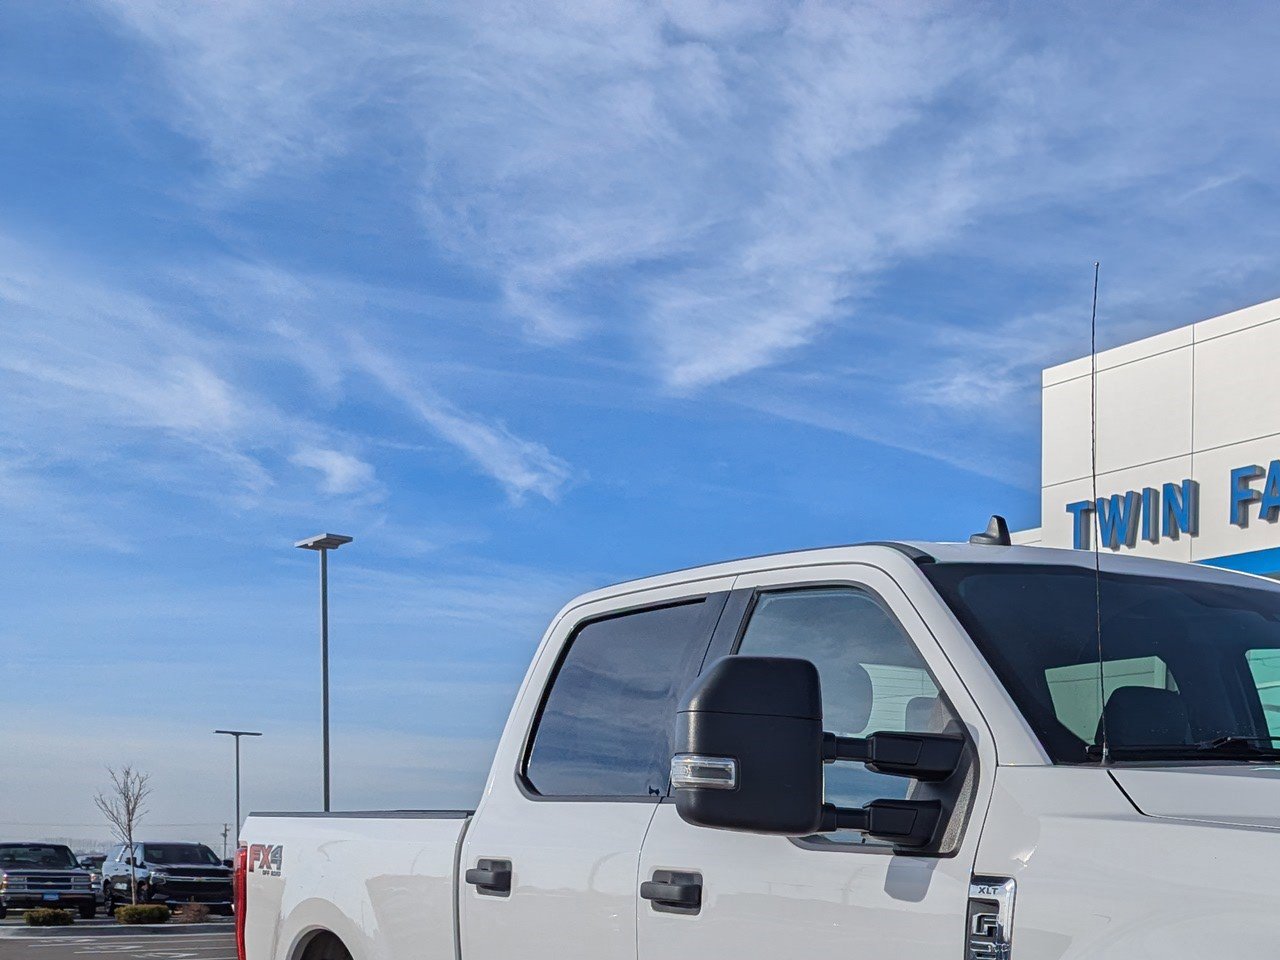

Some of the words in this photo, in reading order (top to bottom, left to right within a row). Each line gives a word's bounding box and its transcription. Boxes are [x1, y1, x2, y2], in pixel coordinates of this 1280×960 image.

[1066, 479, 1200, 551] TWIN
[249, 843, 284, 873] FX4
[978, 886, 999, 895] XLT
